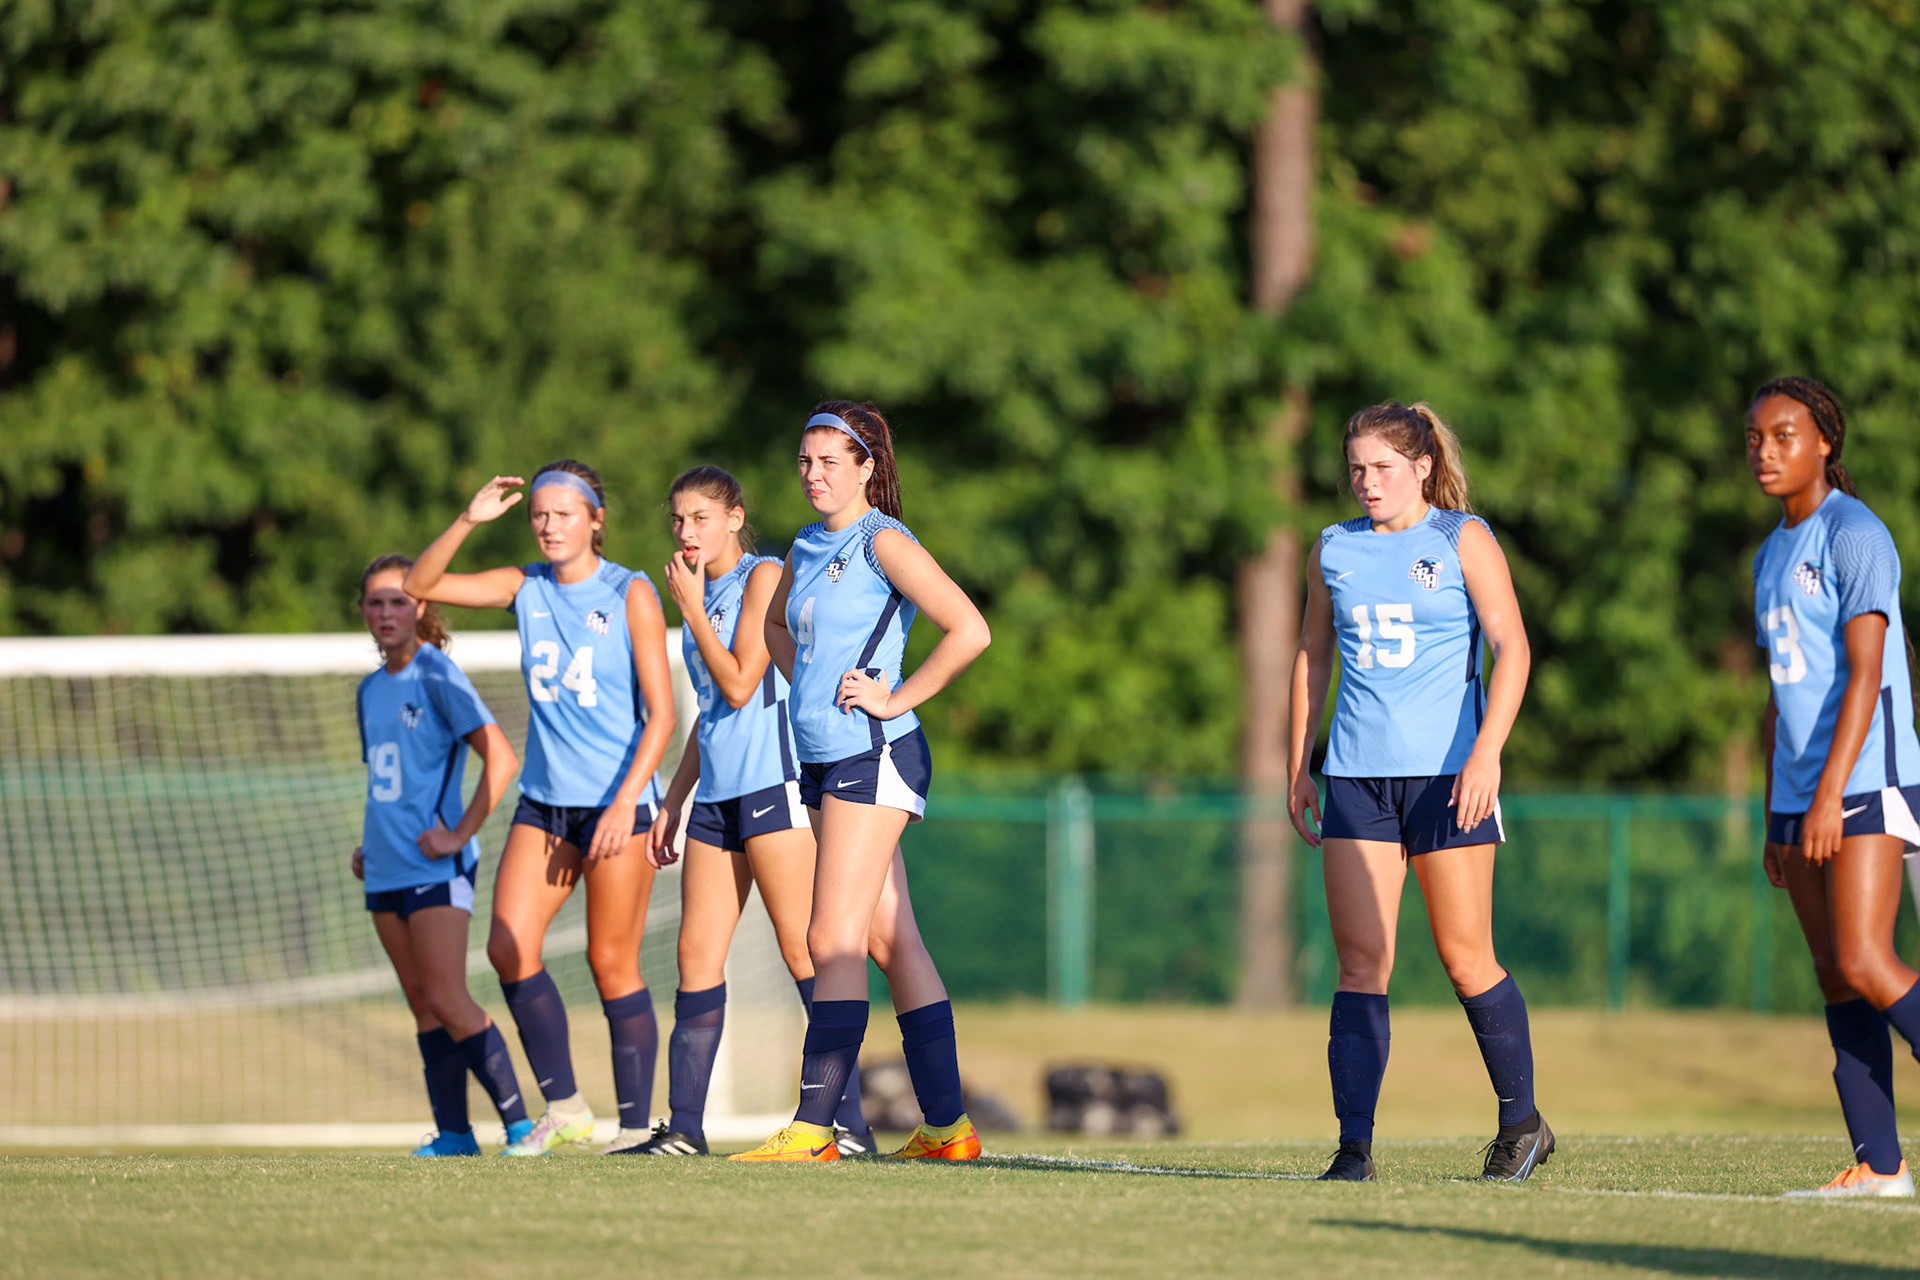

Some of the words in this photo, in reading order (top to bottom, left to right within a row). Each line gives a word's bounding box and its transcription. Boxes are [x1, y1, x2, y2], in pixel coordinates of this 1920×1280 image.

[1409, 562, 1438, 589] SBA
[1352, 603, 1416, 669] 15
[1760, 604, 1807, 685] 3
[530, 640, 598, 707] 24
